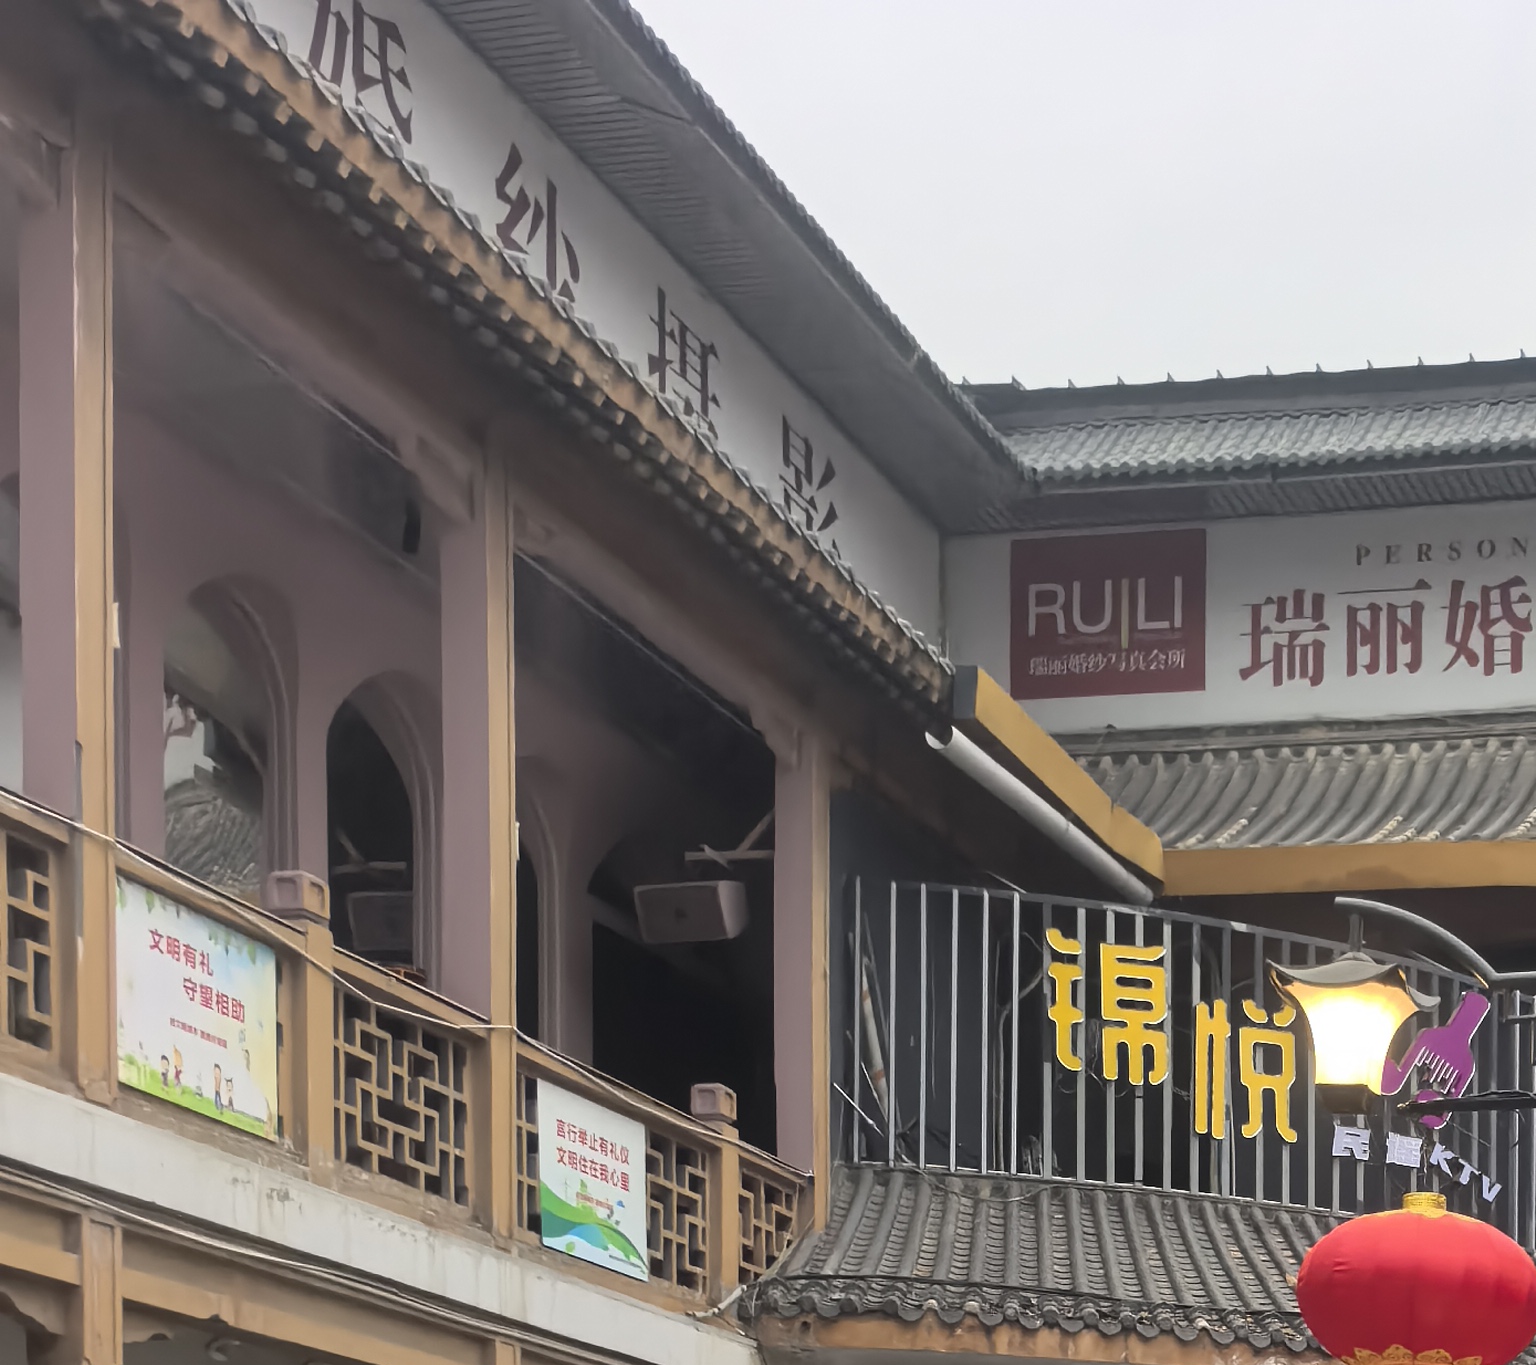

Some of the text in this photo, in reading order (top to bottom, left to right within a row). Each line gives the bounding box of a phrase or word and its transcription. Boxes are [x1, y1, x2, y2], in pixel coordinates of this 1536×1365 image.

[148, 928, 214, 977] 文明有礼
[182, 977, 245, 1024] 守望相助
[1045, 927, 1298, 1143] 锦悦
[556, 1146, 630, 1193] 文明住在我心里
